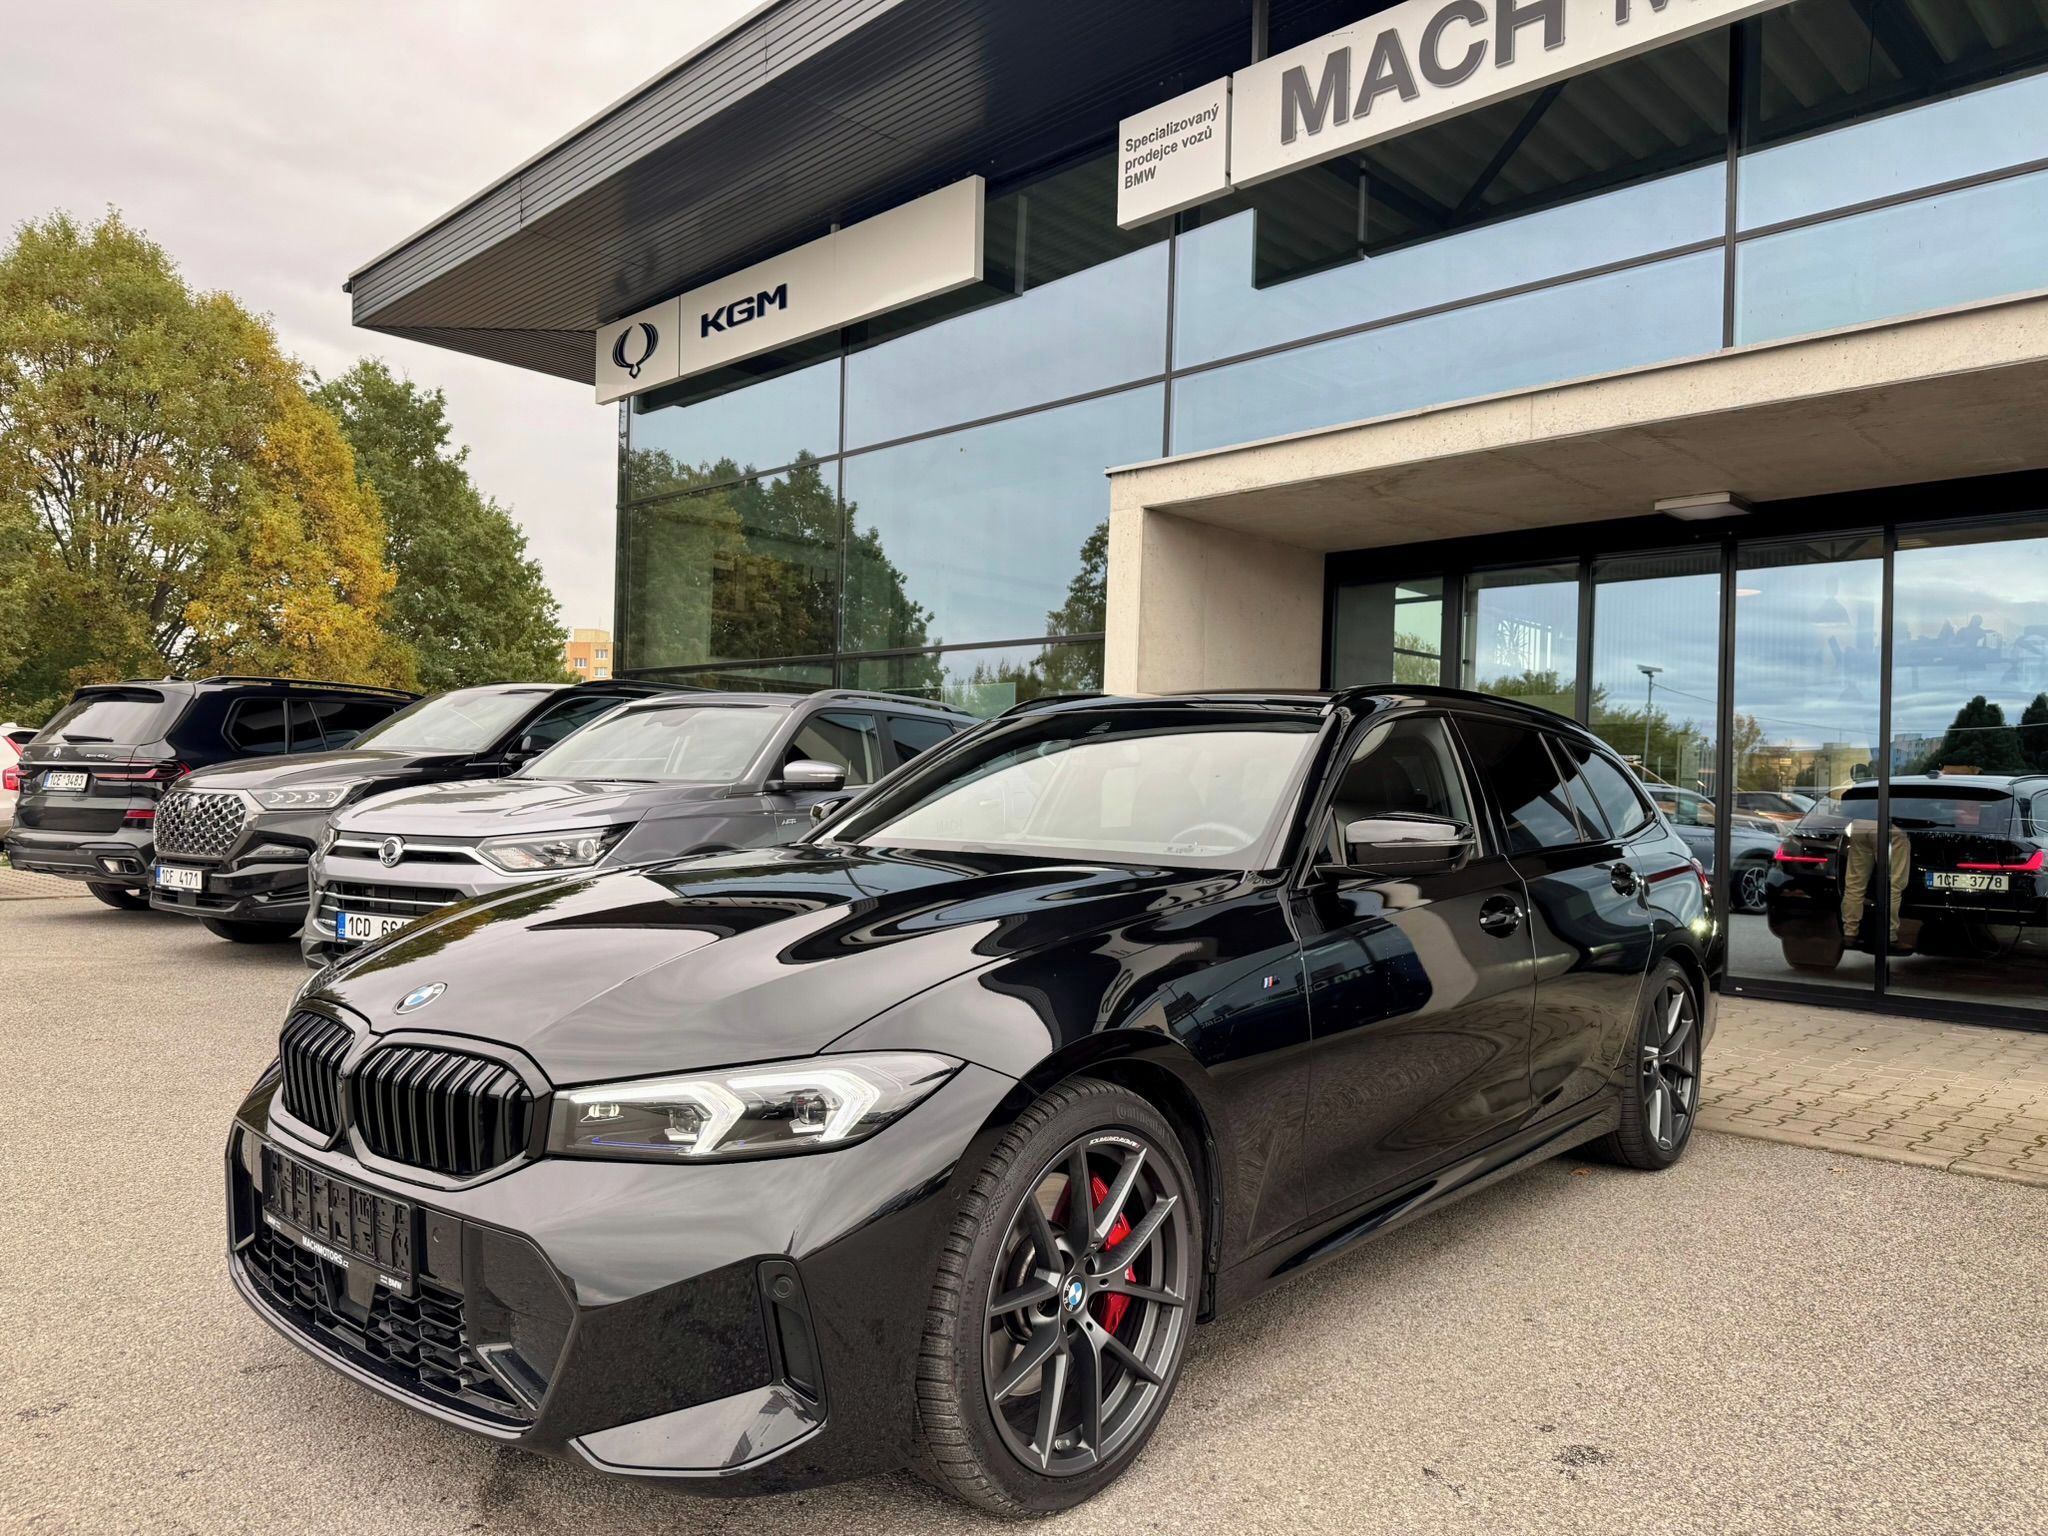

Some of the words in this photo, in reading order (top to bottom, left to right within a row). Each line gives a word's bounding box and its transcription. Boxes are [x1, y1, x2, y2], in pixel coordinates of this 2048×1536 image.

[1281, 0, 1566, 145] MACH
[1125, 103, 1219, 152] Specializovaný
[1125, 142, 1178, 174] prodejce
[1182, 126, 1213, 148] vozů
[1125, 166, 1156, 189] BMW
[701, 283, 787, 338] KGM
[162, 869, 174, 883] 1CF
[179, 871, 198, 887] 4171
[1937, 874, 1960, 886] 1CF
[1970, 876, 2002, 888] 3778
[349, 916, 371, 937] 1CD
